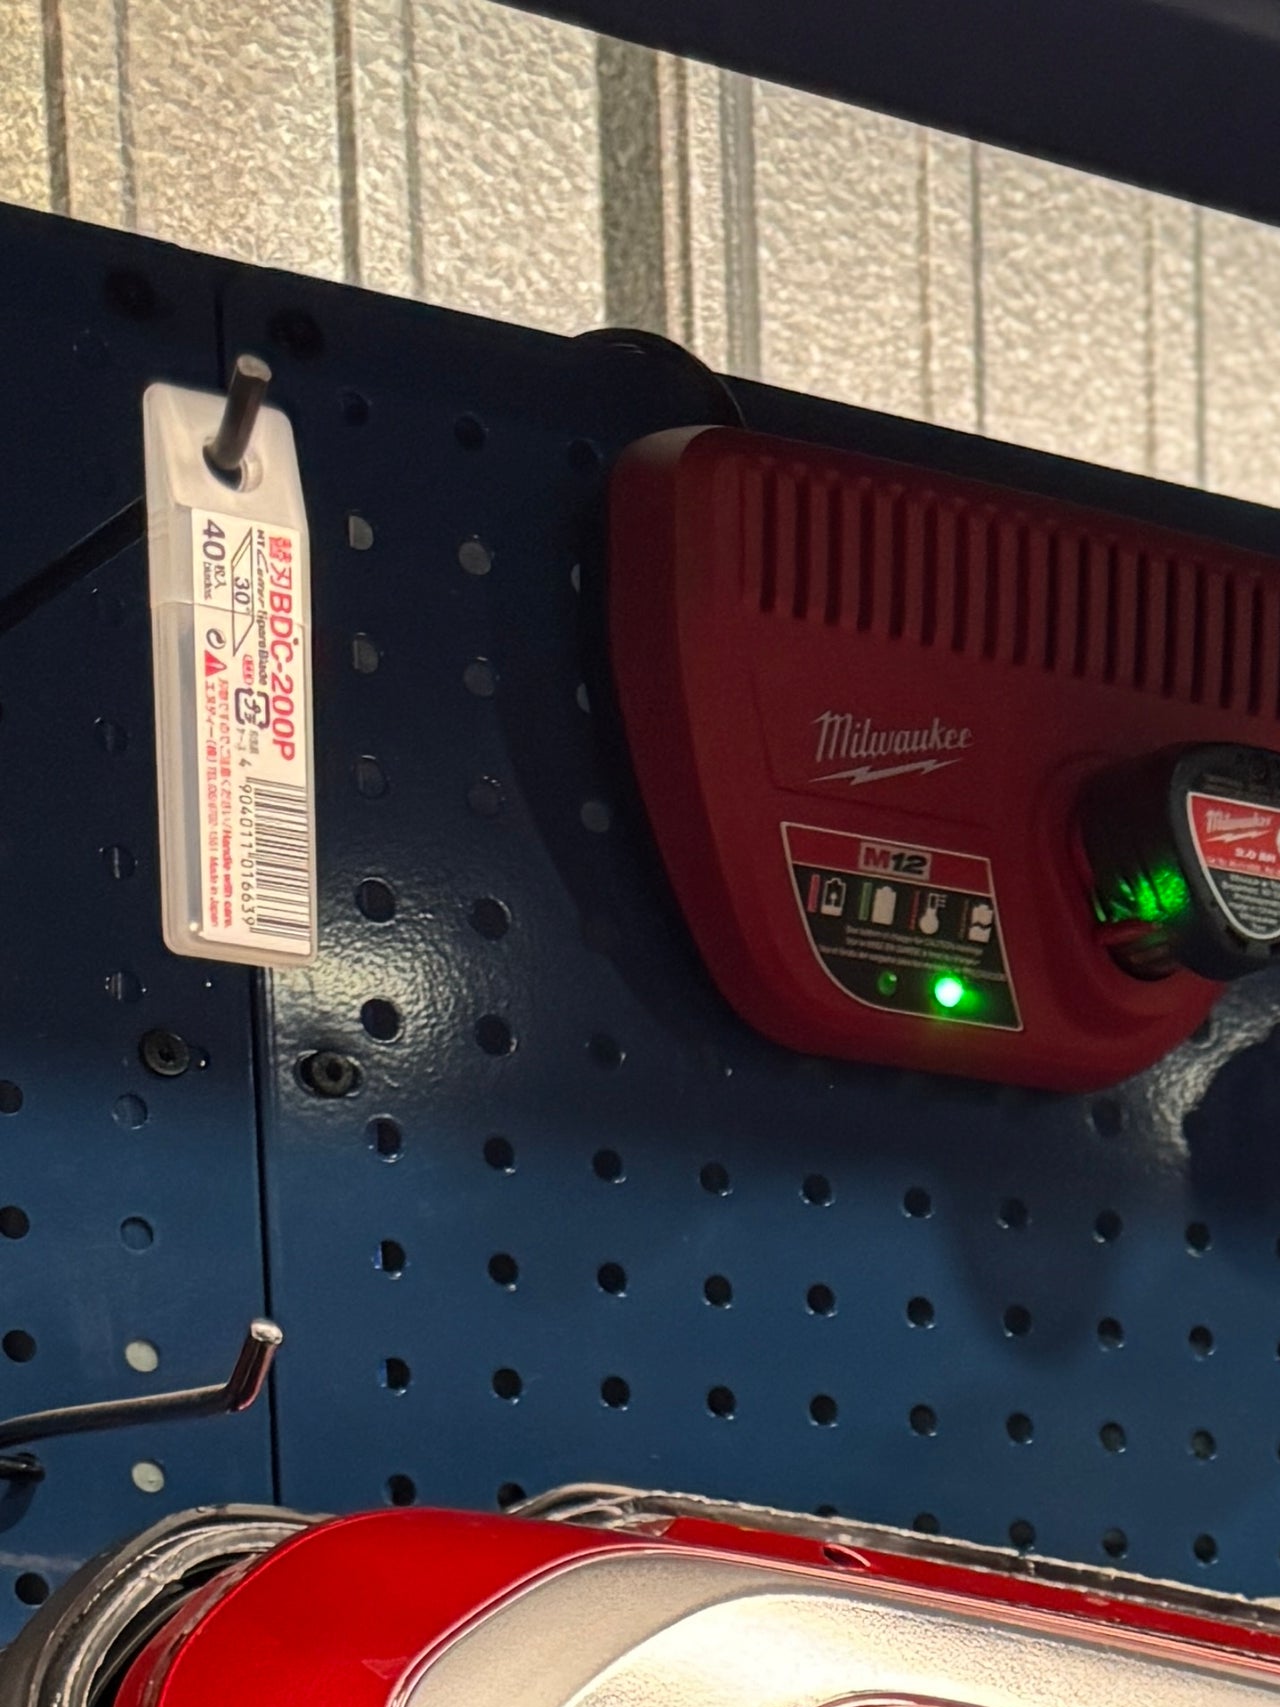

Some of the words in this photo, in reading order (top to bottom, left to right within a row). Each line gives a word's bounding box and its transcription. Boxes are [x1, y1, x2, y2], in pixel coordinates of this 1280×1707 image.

[811, 710, 974, 763] Milwaukee
[238, 783, 254, 849] 904011
[863, 847, 928, 876] M12
[240, 858, 256, 926] 016639
